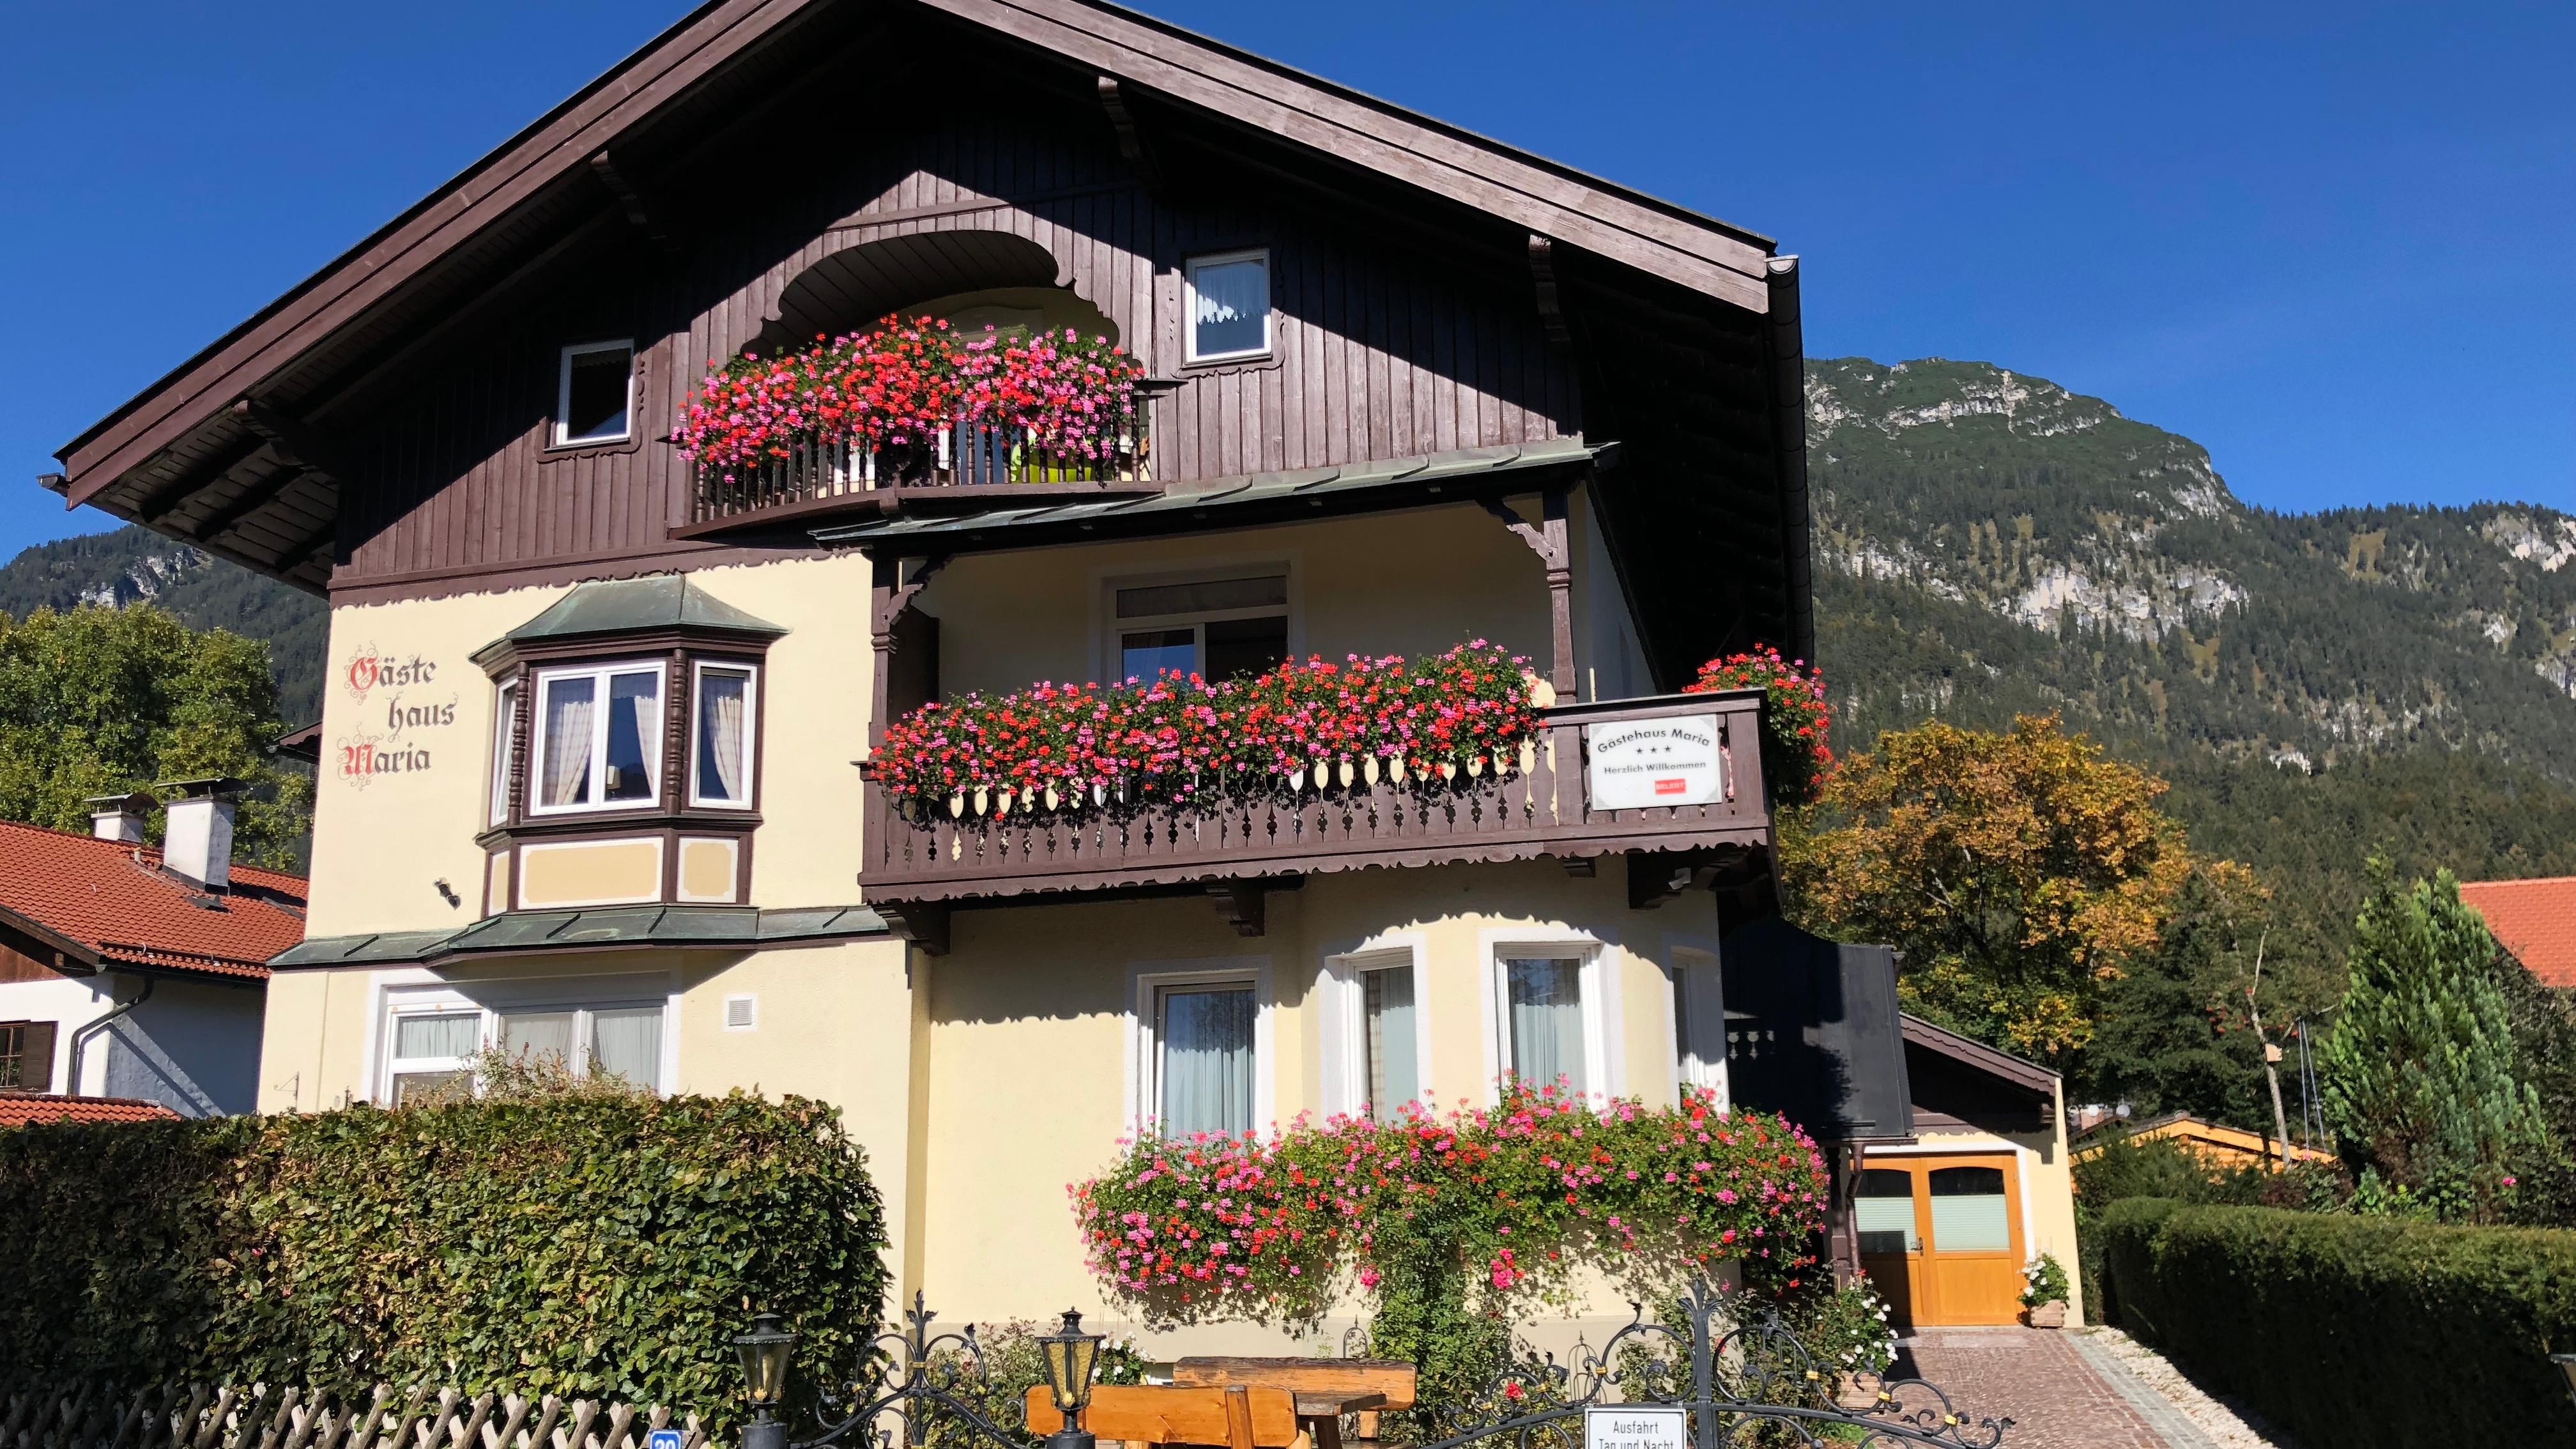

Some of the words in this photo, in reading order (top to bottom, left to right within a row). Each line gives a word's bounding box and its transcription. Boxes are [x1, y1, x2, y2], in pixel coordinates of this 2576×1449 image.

[349, 653, 437, 691] Gäste
[387, 694, 458, 737] haus
[1598, 729, 1666, 753] Gästehaus
[1671, 728, 1710, 747] Maria
[343, 741, 432, 776] Maria
[1604, 765, 1643, 774] Herzlich
[1646, 761, 1706, 772] Willkommen
[1613, 1420, 1659, 1434] Ausfahrt
[1643, 1439, 1674, 1449] Nacht
